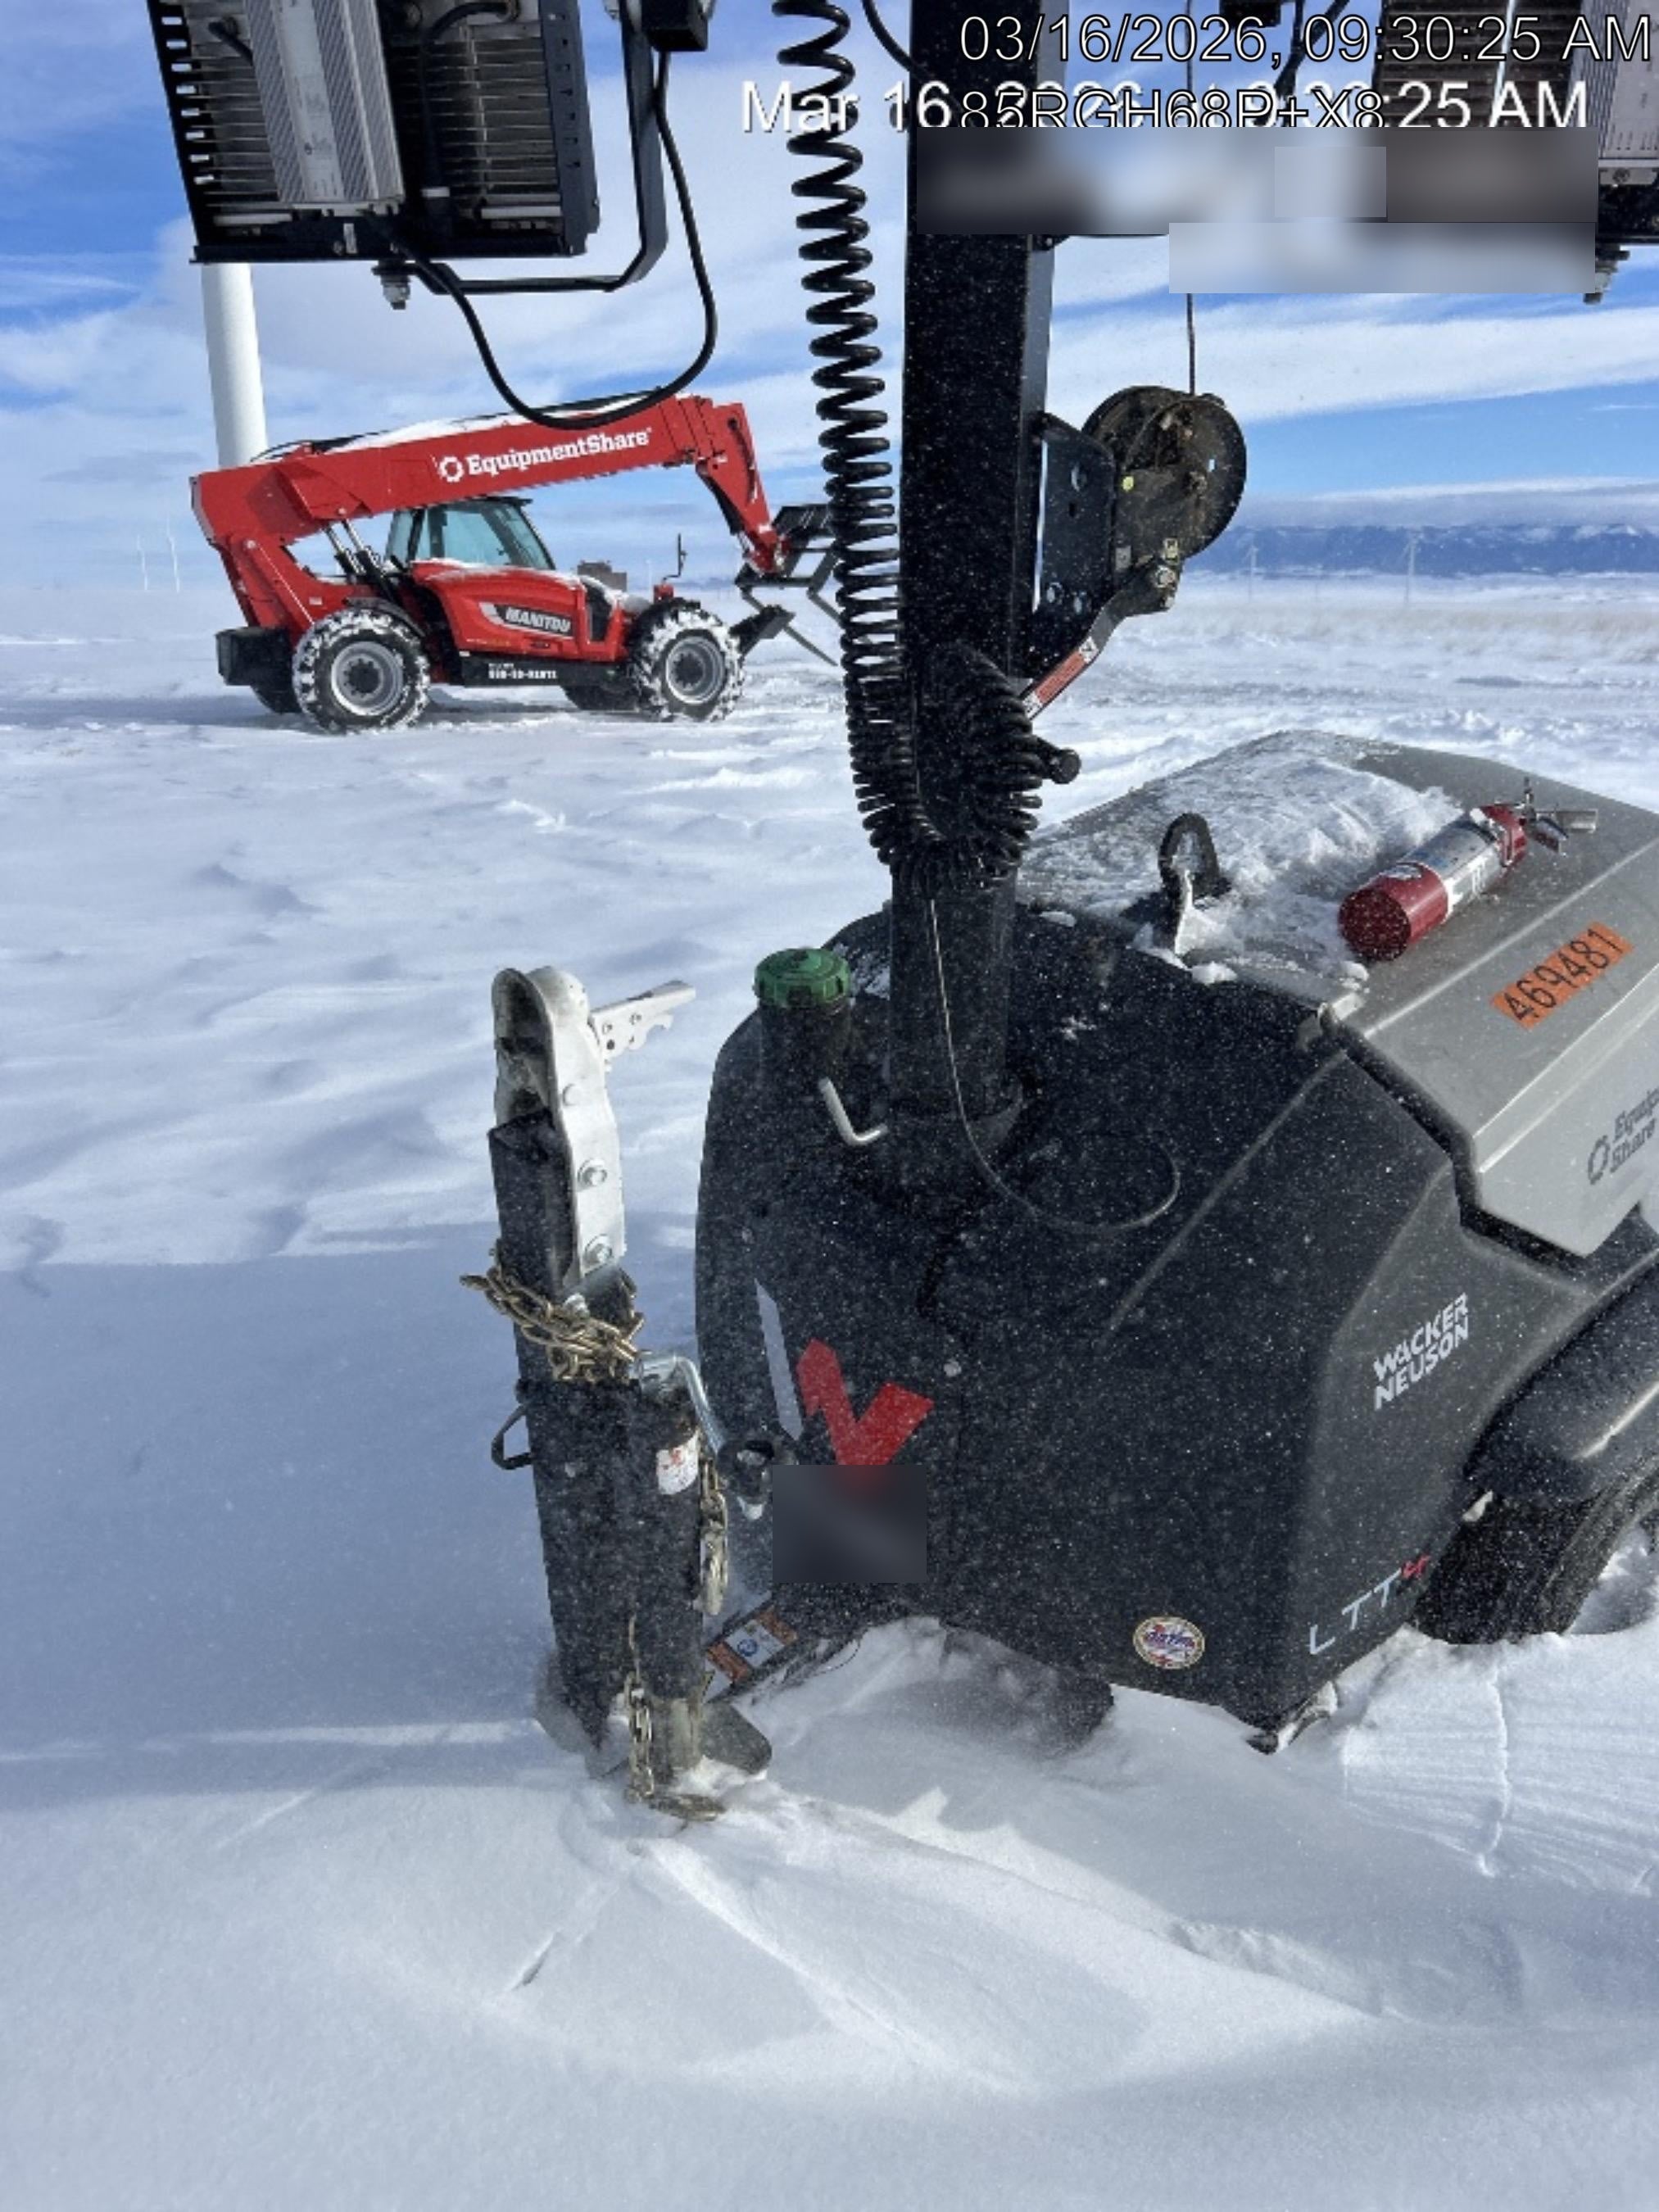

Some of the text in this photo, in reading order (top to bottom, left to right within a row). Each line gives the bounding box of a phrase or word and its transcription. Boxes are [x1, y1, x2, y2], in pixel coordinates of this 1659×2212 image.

[466, 430, 650, 477] EquipmentShare
[505, 606, 571, 633] MANITOU
[1504, 928, 1623, 1021] 469481
[1613, 1086, 1659, 1144] Equip
[1373, 1292, 1468, 1382] WACKER
[1375, 1316, 1469, 1412] NEUSON
